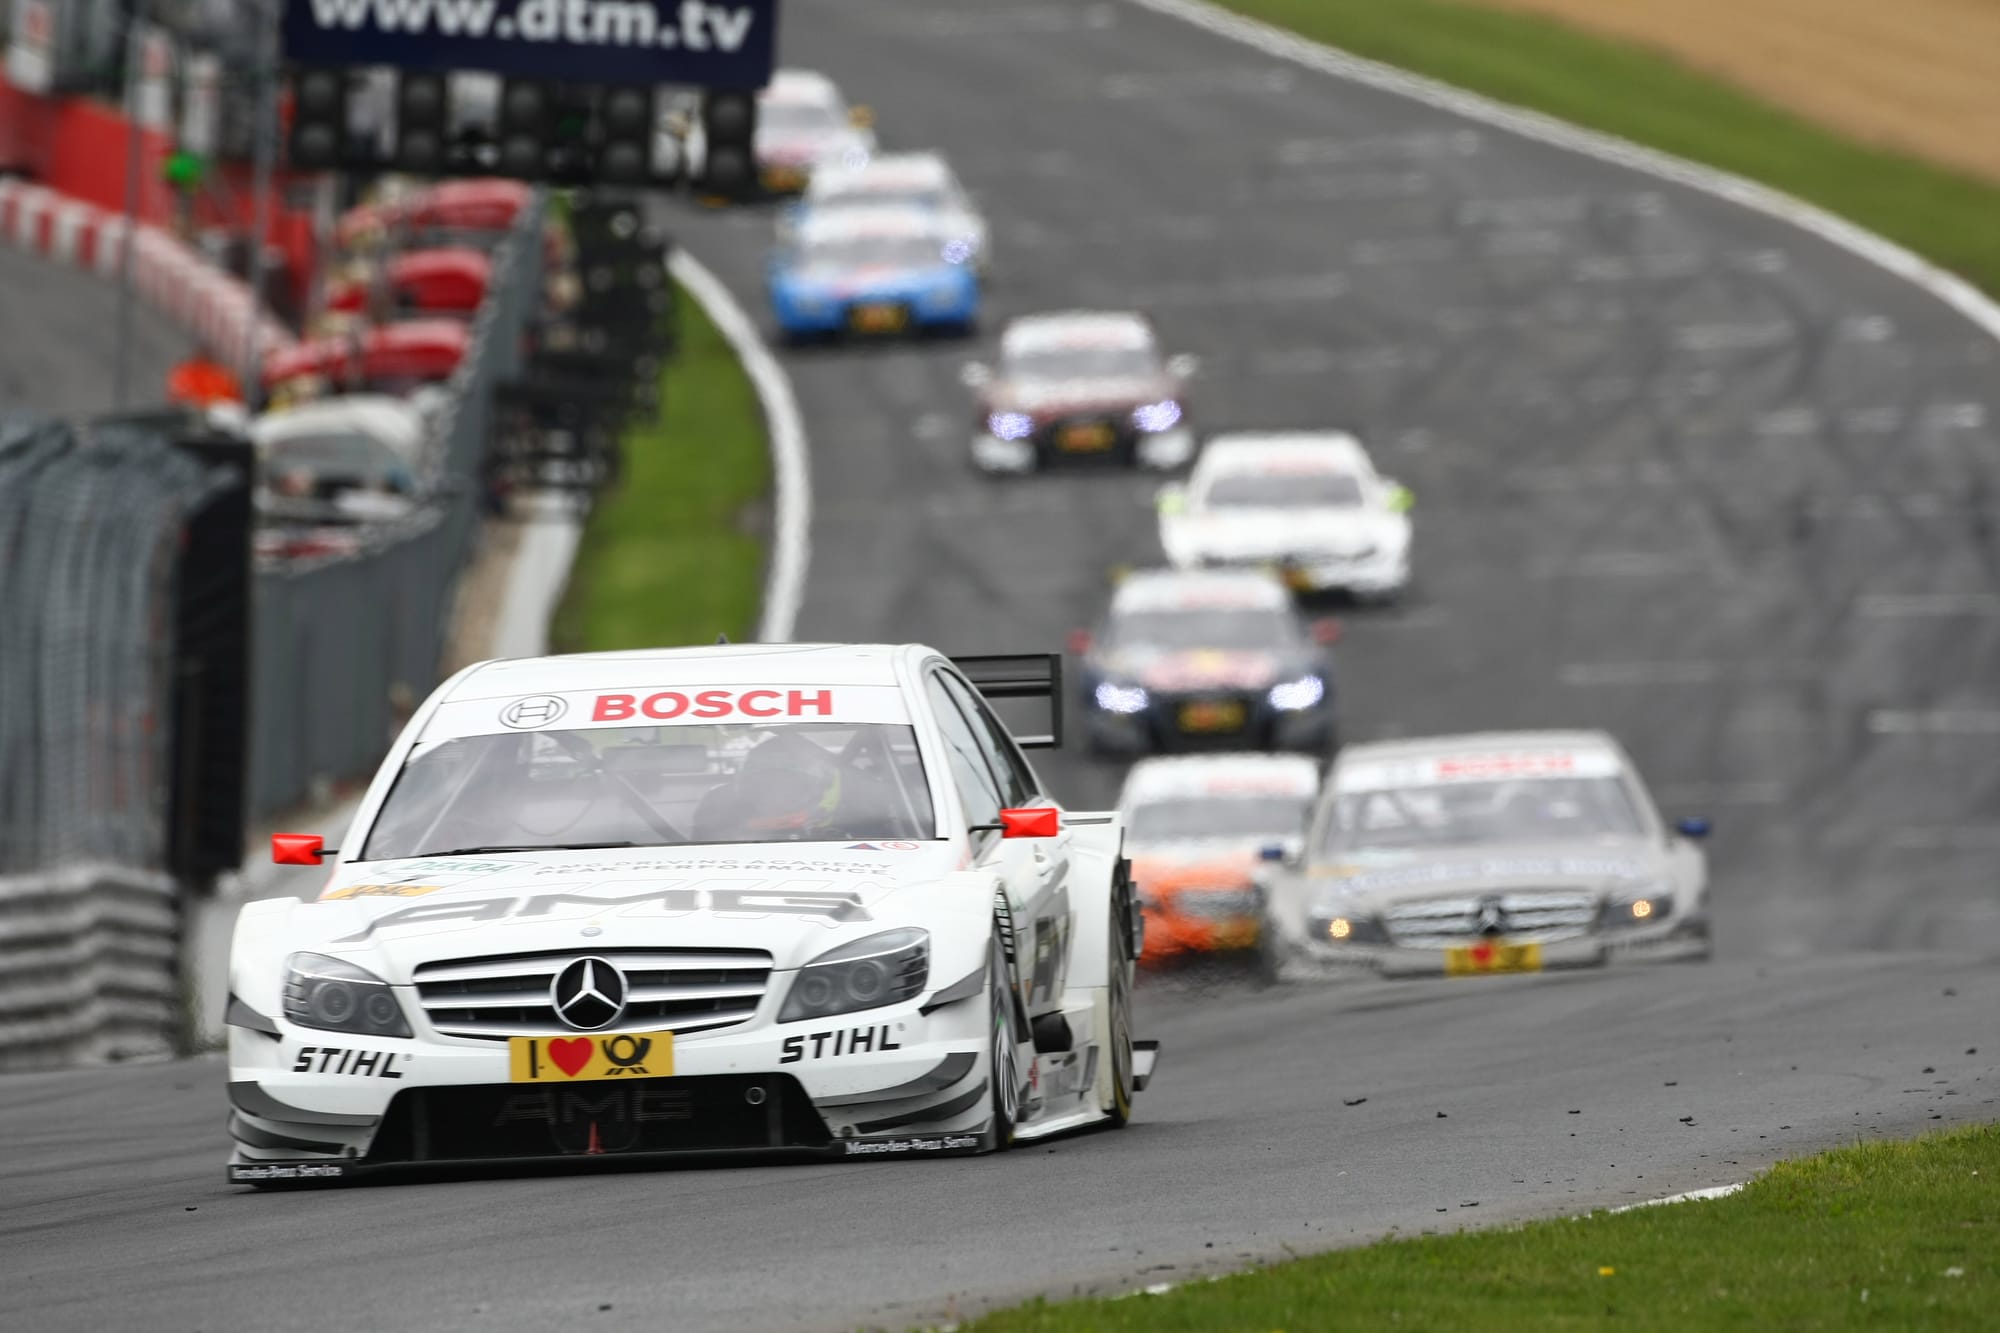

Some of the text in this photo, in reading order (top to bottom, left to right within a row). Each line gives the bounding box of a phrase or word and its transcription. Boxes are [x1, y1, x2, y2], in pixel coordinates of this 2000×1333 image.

[312, 0, 753, 51] www.dtm.tv
[591, 689, 833, 722] BOSCH
[534, 865, 889, 876] PEAK PERFORMANCE
[329, 888, 874, 943] AMG
[778, 1024, 902, 1064] STIHL
[292, 1046, 403, 1079] STIHL
[493, 1089, 695, 1127] AMG
[844, 1138, 942, 1155] Mercedes-Benz
[297, 1164, 343, 1178] Service
